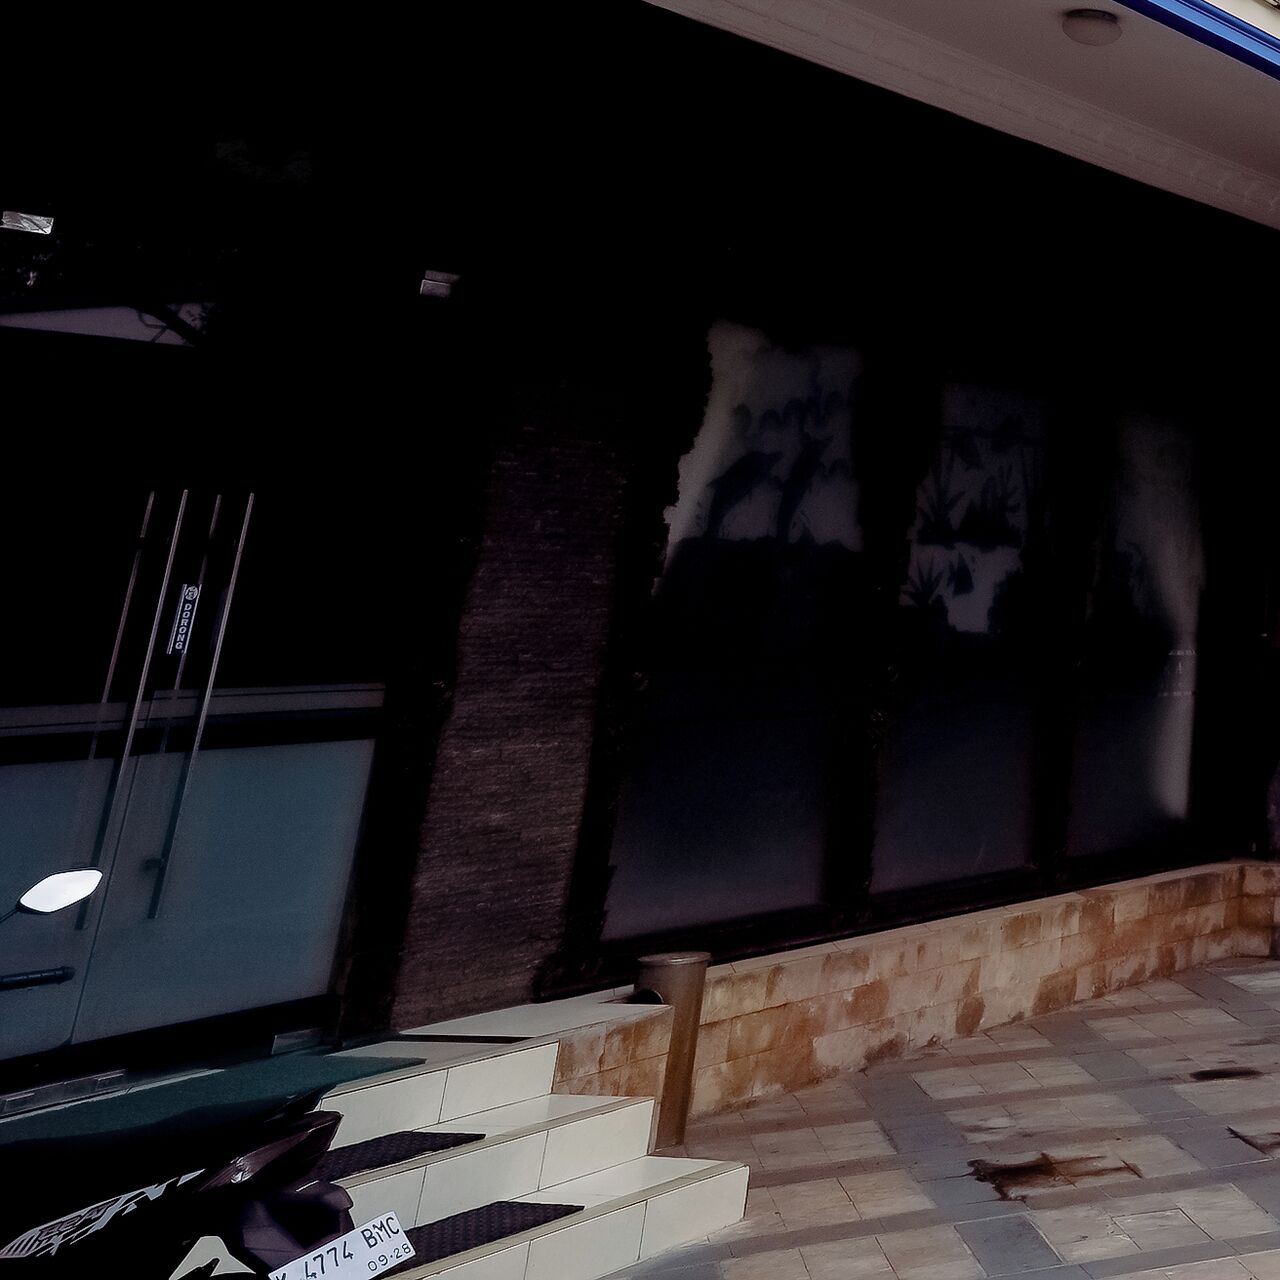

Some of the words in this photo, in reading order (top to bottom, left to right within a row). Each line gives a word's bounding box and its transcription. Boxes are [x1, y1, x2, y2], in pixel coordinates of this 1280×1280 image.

[175, 603, 193, 650] DORONG
[304, 1240, 354, 1279] 4774
[361, 1216, 400, 1249] BMC
